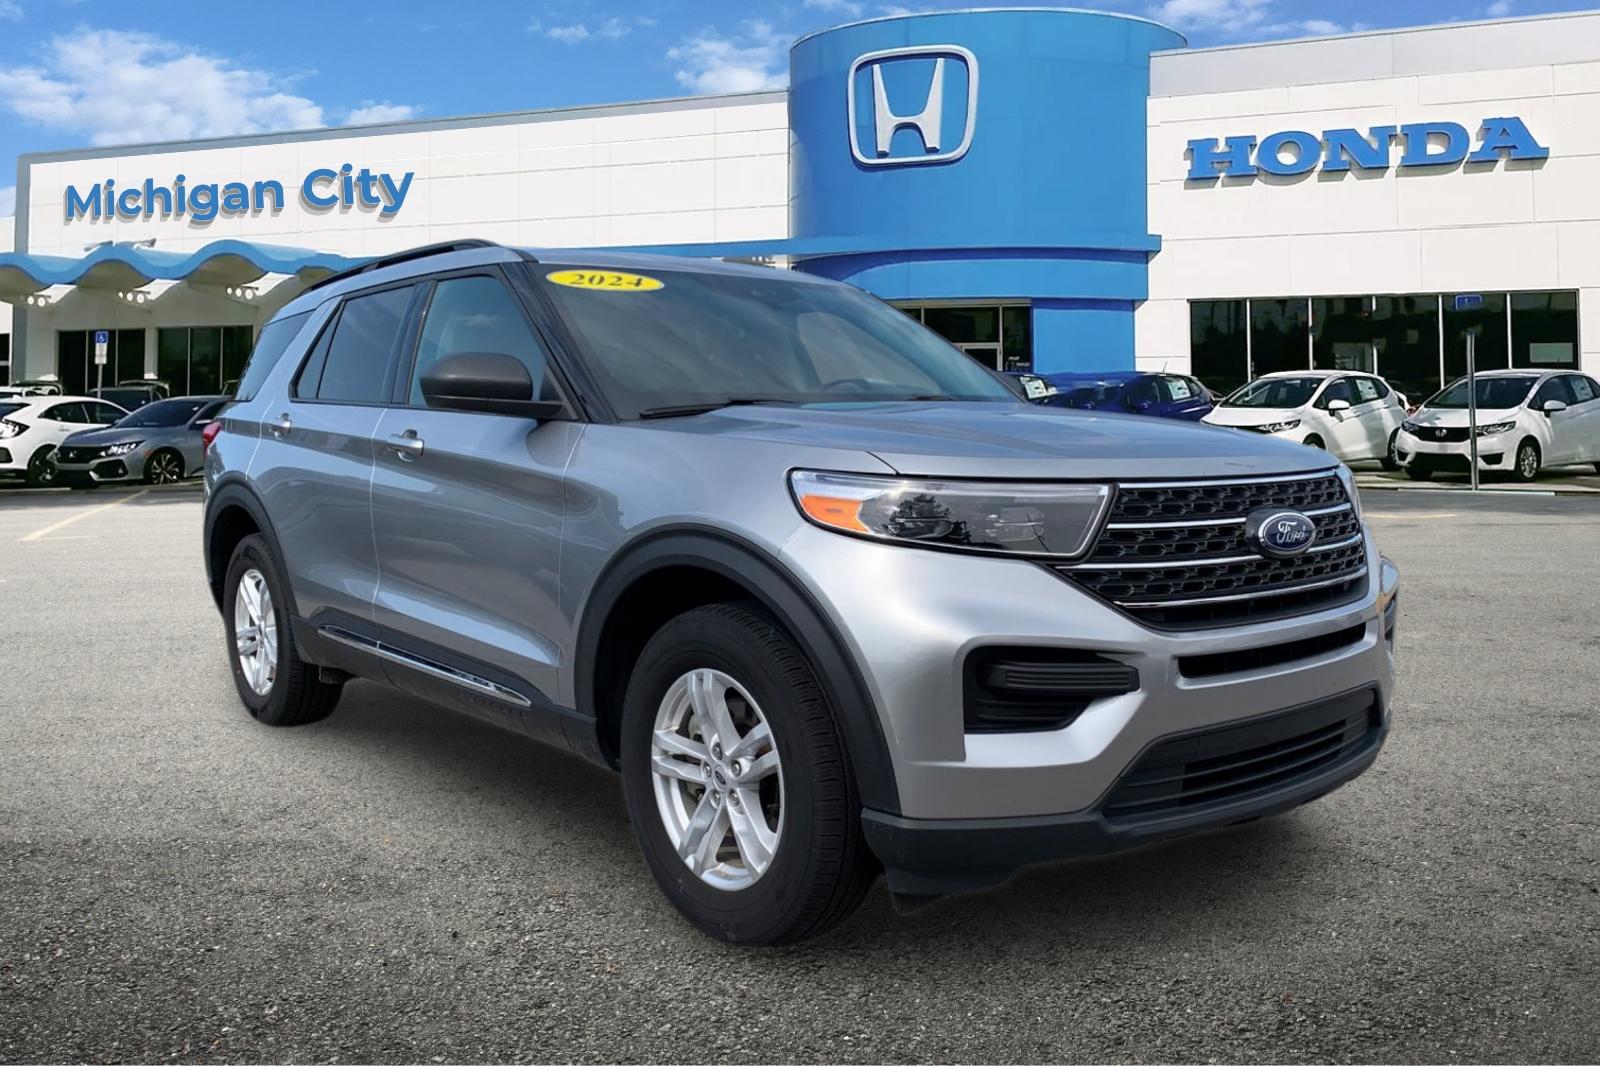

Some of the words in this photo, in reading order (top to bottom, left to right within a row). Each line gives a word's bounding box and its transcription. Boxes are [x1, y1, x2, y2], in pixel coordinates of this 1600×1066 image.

[1185, 116, 1550, 182] HONDA
[65, 173, 285, 224] Michigan
[301, 162, 415, 217] City
[569, 273, 644, 288] 2024
[1276, 520, 1306, 544] Ford
